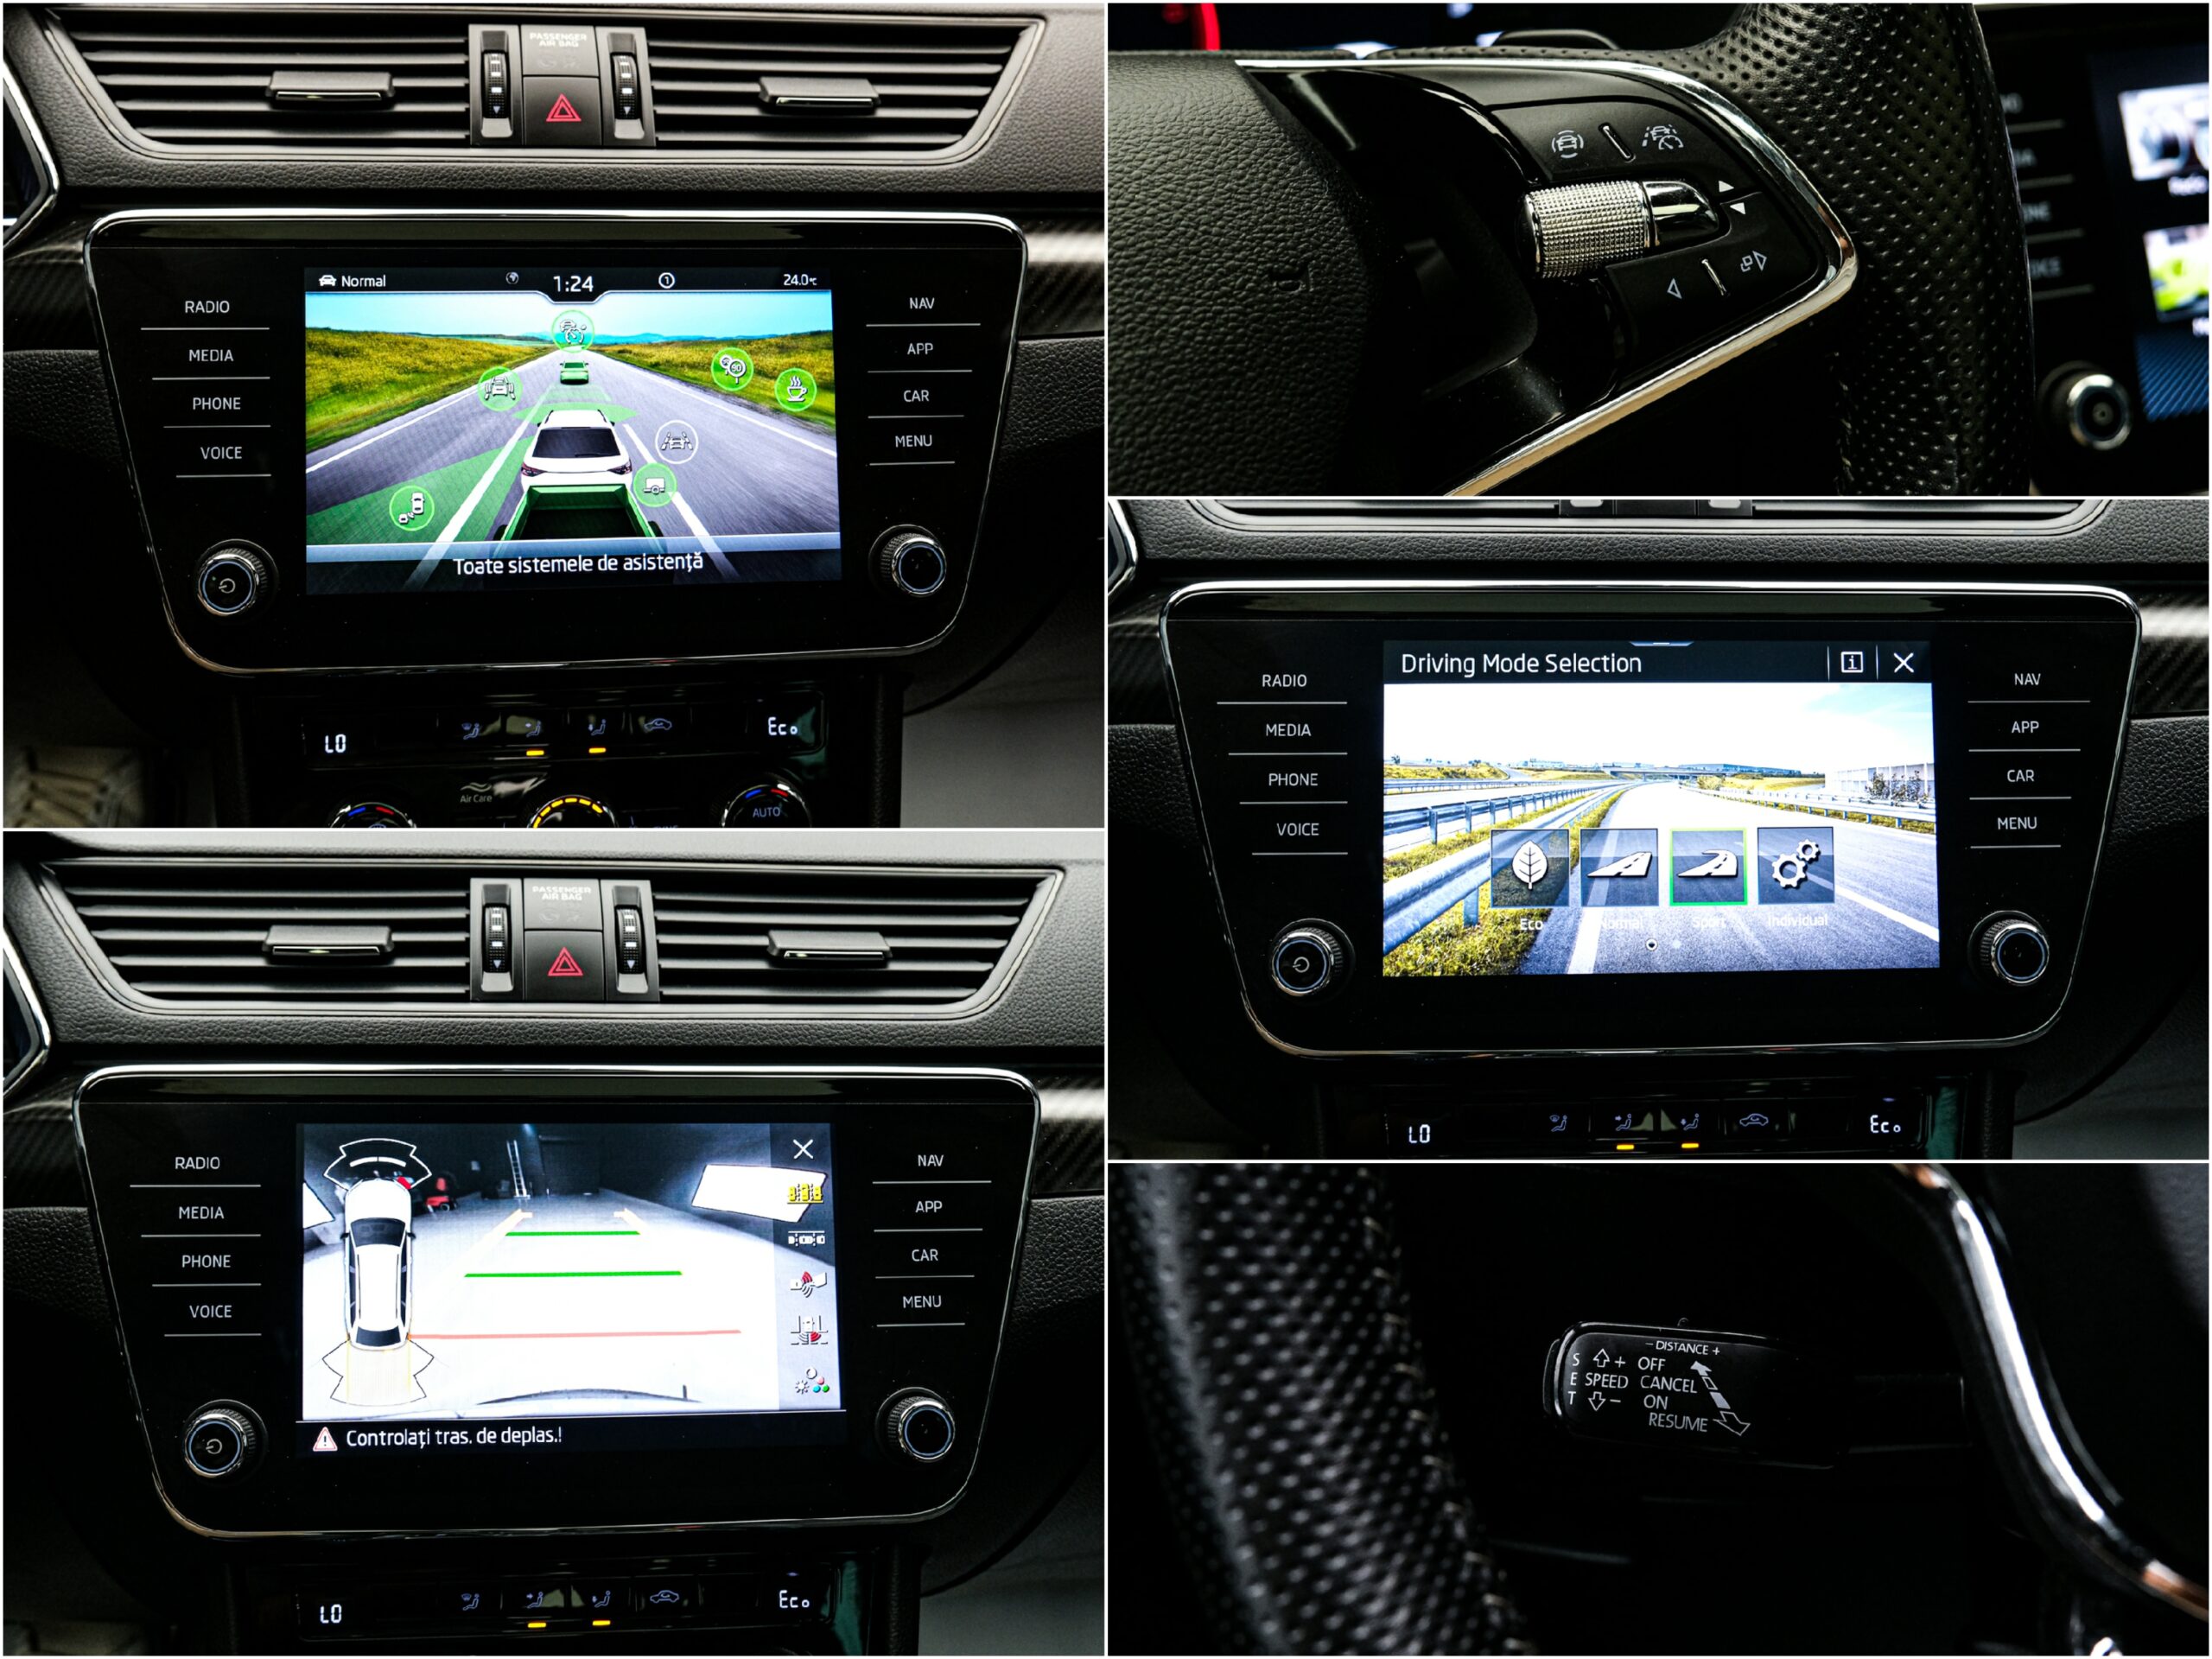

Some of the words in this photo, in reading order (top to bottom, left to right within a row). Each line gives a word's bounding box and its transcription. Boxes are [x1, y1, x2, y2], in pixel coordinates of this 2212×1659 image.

[529, 32, 588, 41] PASSENGER
[340, 274, 387, 289] Normal
[553, 275, 594, 293] 1:24
[184, 300, 231, 314] RADIO
[909, 296, 935, 309] NAV
[188, 349, 234, 362] MEDIA
[906, 342, 934, 355] APP
[903, 389, 930, 403] CAR
[192, 397, 241, 410] PHONE
[894, 435, 933, 448] MENU
[200, 446, 243, 460] VOICE
[453, 558, 504, 575] Toate
[508, 555, 593, 574] sistemele
[597, 554, 618, 571] de
[1402, 652, 1476, 678] Driving
[1483, 652, 1540, 673] Mode
[1545, 652, 1643, 673] Selection
[1262, 673, 1308, 688] RADIO
[2014, 672, 2042, 686] NAV
[1266, 723, 1312, 737] MEDIA
[2011, 721, 2040, 734] APP
[325, 734, 346, 754] LO
[1268, 772, 1319, 786] PHONE
[2006, 769, 2035, 783] CAR
[460, 794, 473, 803] Air
[473, 793, 493, 803] Care
[753, 804, 782, 818] AUTO
[1276, 822, 1320, 836] VOICE
[1997, 816, 2038, 830] MENU
[531, 886, 592, 894] PASSENGER
[541, 893, 560, 901] AIR
[561, 893, 583, 901] BAG
[1519, 918, 1544, 931] Eco
[1692, 915, 1726, 931] Sport
[1768, 913, 1828, 928] Individual
[1408, 1123, 1431, 1144] LO
[175, 1156, 221, 1170] RADIO
[918, 1154, 944, 1167] NAV
[178, 1205, 225, 1219] MEDIA
[915, 1200, 943, 1213] APP
[181, 1254, 232, 1268] PHONE
[911, 1249, 939, 1262] CAR
[902, 1294, 942, 1309] MENU
[188, 1305, 232, 1319] VOICE
[1656, 1339, 1709, 1356] DISTANCE
[1637, 1356, 1666, 1371] OFF
[1585, 1371, 1629, 1389] SPEED
[1640, 1375, 1698, 1394] CANCEL
[1643, 1394, 1669, 1410] ON
[1649, 1412, 1709, 1433] RESUME
[435, 1429, 473, 1446] tras.
[476, 1427, 498, 1445] de
[500, 1426, 563, 1447] deplas.!
[320, 1604, 342, 1624] LO
